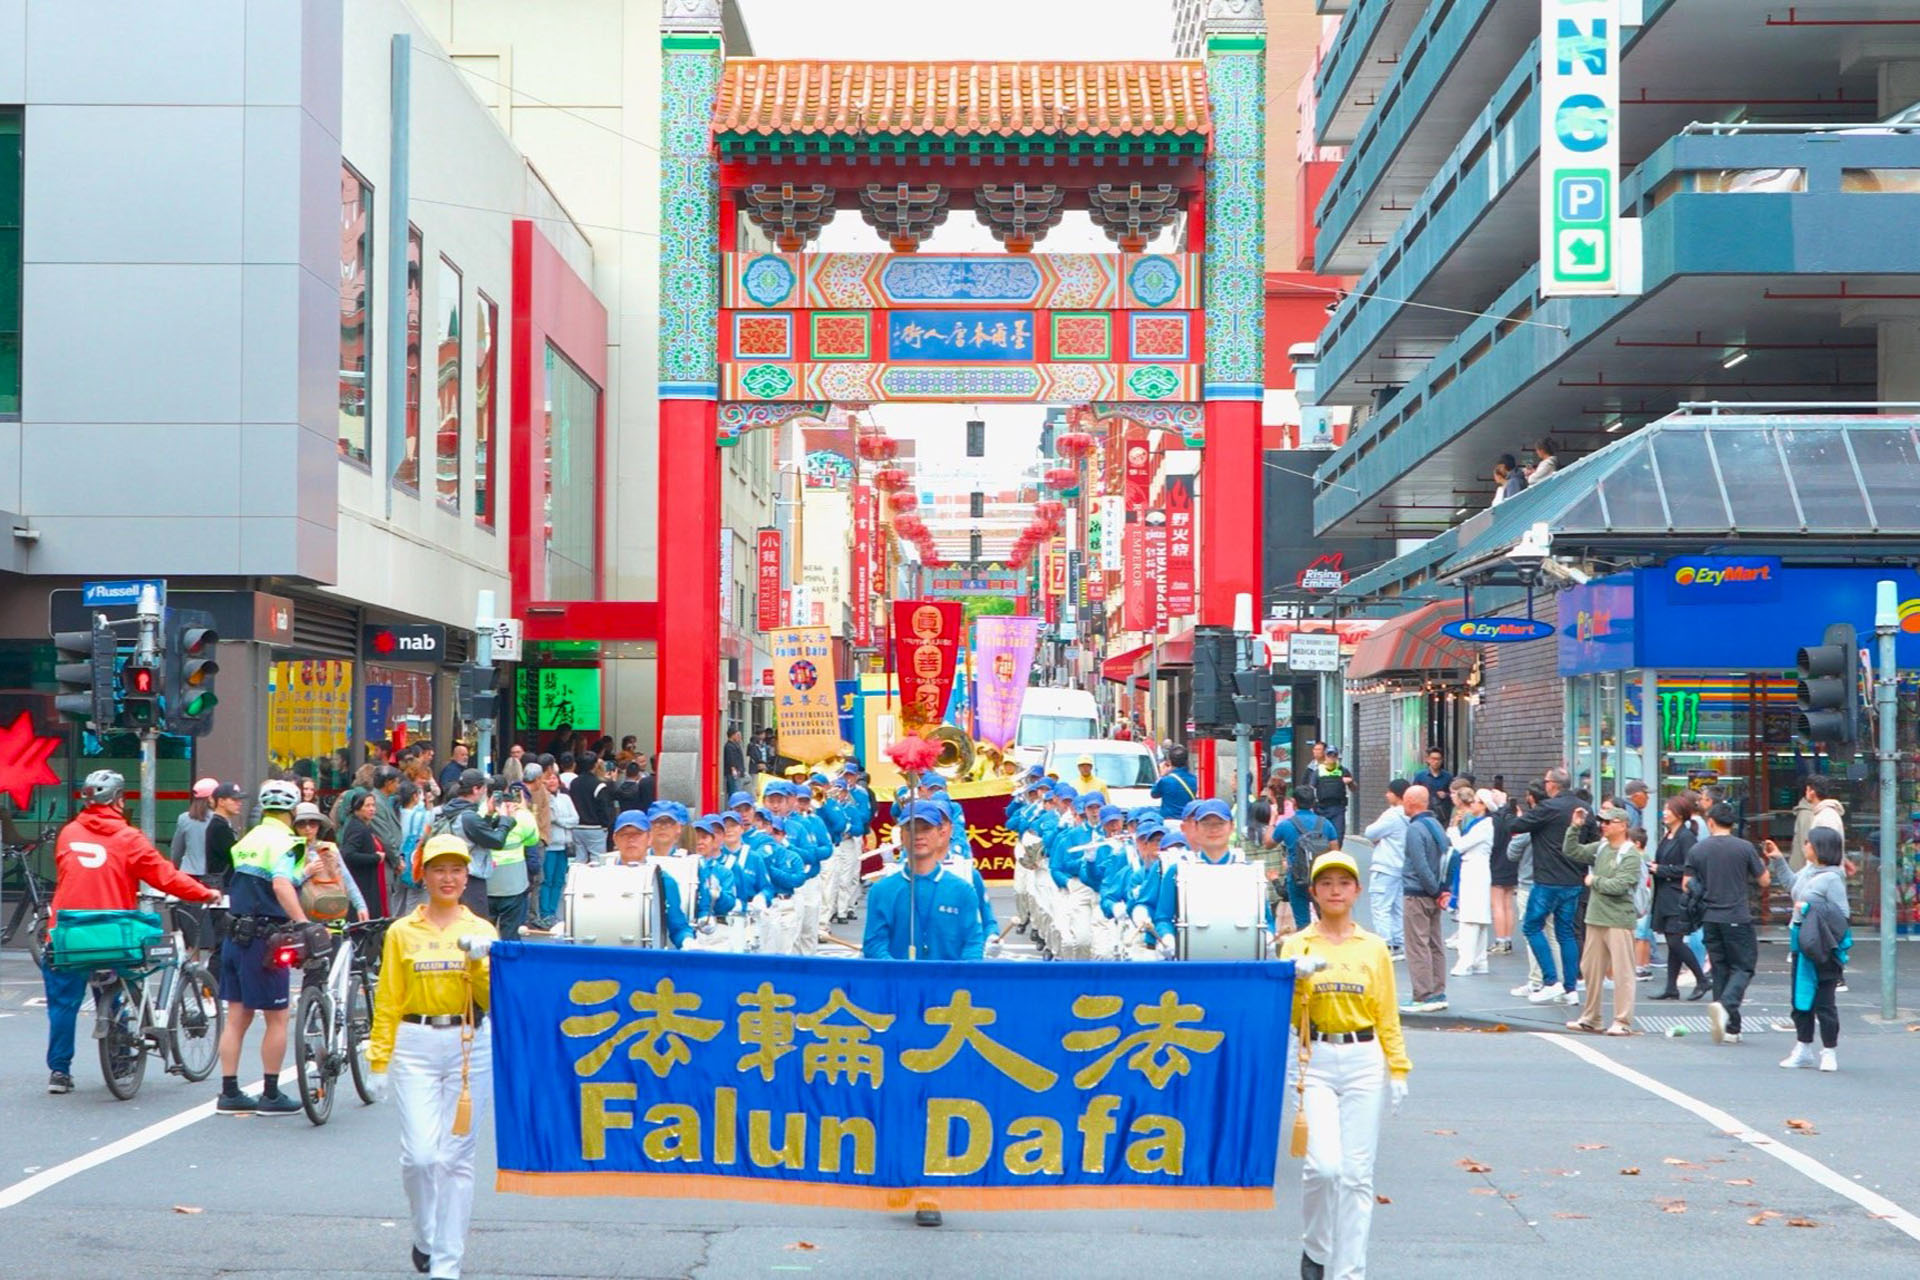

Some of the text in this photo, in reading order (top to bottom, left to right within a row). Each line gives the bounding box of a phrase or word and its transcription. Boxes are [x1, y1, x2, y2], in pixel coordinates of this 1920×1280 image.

[1569, 184, 1595, 215] P
[1132, 531, 1143, 588] EMPEROR
[858, 567, 866, 602] EMPRESS
[1156, 542, 1168, 627] TEPPANYAKI
[1302, 579, 1342, 589] Embers
[1306, 569, 1342, 581] Rising
[1695, 565, 1771, 586] EzyMart
[96, 585, 140, 598] Russell
[760, 579, 770, 621] STREET
[858, 616, 866, 641] CHINA
[1475, 622, 1537, 638] EzyMart
[399, 633, 436, 650] nab
[1292, 648, 1337, 656] MEDICAL CLINIC
[560, 977, 1226, 1093] 法輪大法
[580, 1082, 1186, 1177] Falun Dafa
